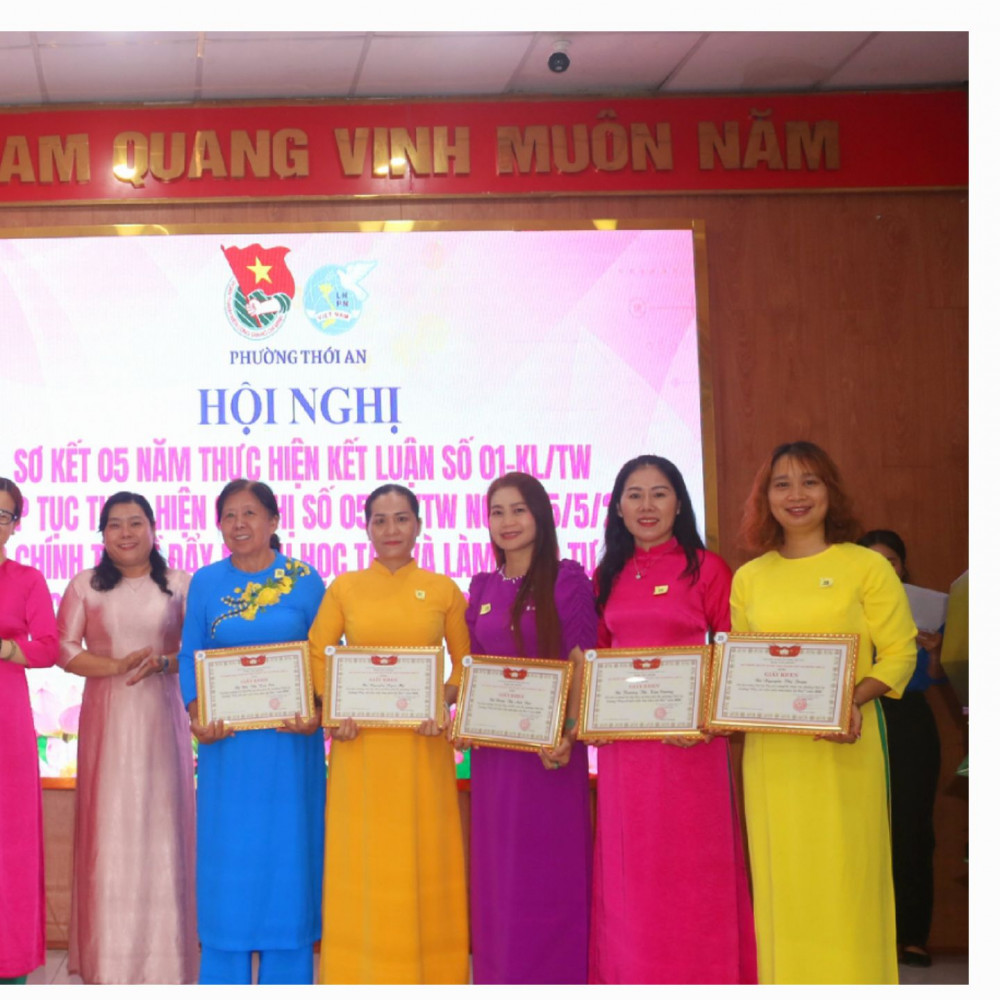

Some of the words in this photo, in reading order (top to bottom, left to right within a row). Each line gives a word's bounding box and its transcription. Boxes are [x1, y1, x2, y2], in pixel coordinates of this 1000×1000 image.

[112, 126, 310, 188] QUANG
[334, 126, 471, 178] VINH
[495, 109, 674, 175] MUÔN
[697, 107, 842, 172] NĂM
[230, 347, 298, 365] PHƯỜNG
[300, 346, 341, 365] THỚI
[344, 349, 367, 364] AN
[197, 381, 279, 436] HỘI
[288, 386, 403, 434] NGHỊ
[13, 445, 43, 484] SƠ
[51, 439, 91, 484] KẾT
[97, 447, 129, 483] 05
[136, 438, 191, 483] NĂM
[268, 436, 320, 489] HIỆN
[327, 437, 368, 481] KẾT
[376, 437, 434, 488] LUẬN
[442, 436, 475, 481] SỐ
[479, 444, 592, 481] 01-KL/TW
[36, 495, 79, 539] TỤC
[155, 486, 207, 539] HIỆN
[302, 485, 335, 530] SỐ
